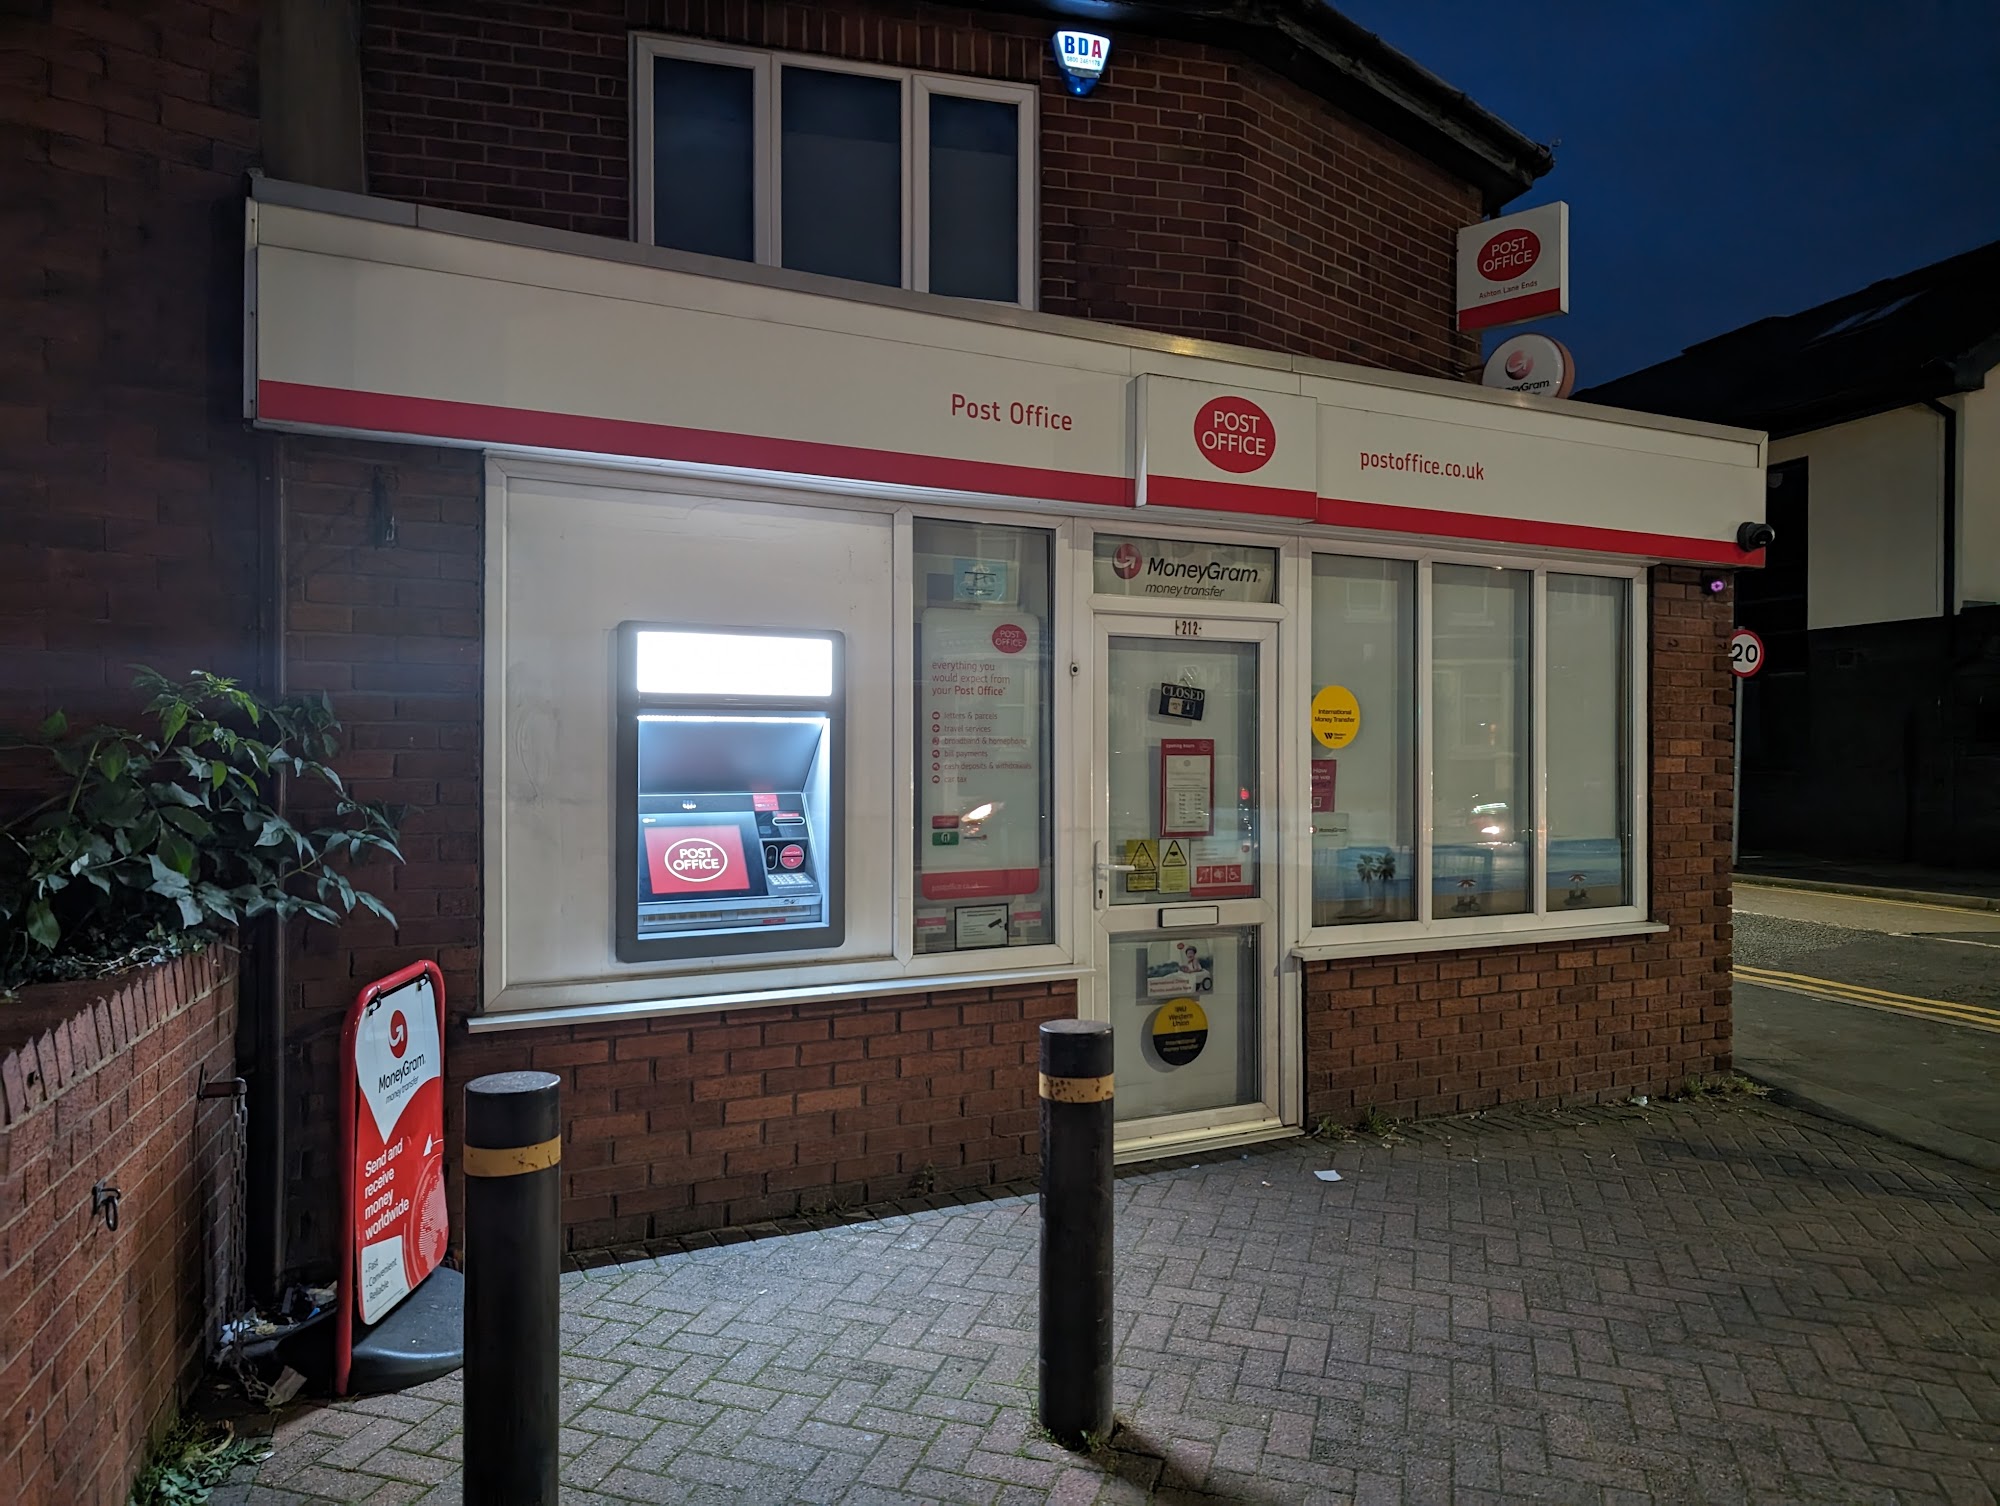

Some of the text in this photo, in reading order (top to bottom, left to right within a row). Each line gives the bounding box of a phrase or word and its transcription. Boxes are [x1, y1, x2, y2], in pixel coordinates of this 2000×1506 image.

[1491, 236, 1528, 257] POST
[1483, 249, 1532, 272] OFFICE
[1479, 289, 1502, 299] Ashton
[1503, 285, 1519, 294] Lane
[952, 393, 1072, 431] Post Office
[1214, 410, 1260, 434] POST
[1202, 430, 1266, 457] OFFICE
[1360, 452, 1484, 480] postoffice.co.uk
[1147, 557, 1259, 584] MoneyGram
[1145, 583, 1225, 597] money transfer
[995, 638, 1023, 647] OFFICE
[1000, 630, 1020, 638] POST
[1731, 643, 1758, 663] 20
[932, 661, 995, 672] everything you
[932, 673, 1011, 684] would expect from
[932, 687, 951, 696] your
[954, 685, 975, 695] Post
[1162, 685, 1204, 701] CLOSED
[965, 725, 992, 733] services
[679, 847, 713, 859] POST
[673, 858, 720, 871] OFFICE
[378, 1053, 425, 1094] MoneyGram
[386, 1075, 419, 1104] money transfer
[365, 1137, 403, 1178] Send and
[365, 1168, 395, 1199] receive
[365, 1189, 394, 1220] money
[365, 1198, 410, 1241] worldwide
[368, 1258, 398, 1287] Convenient
